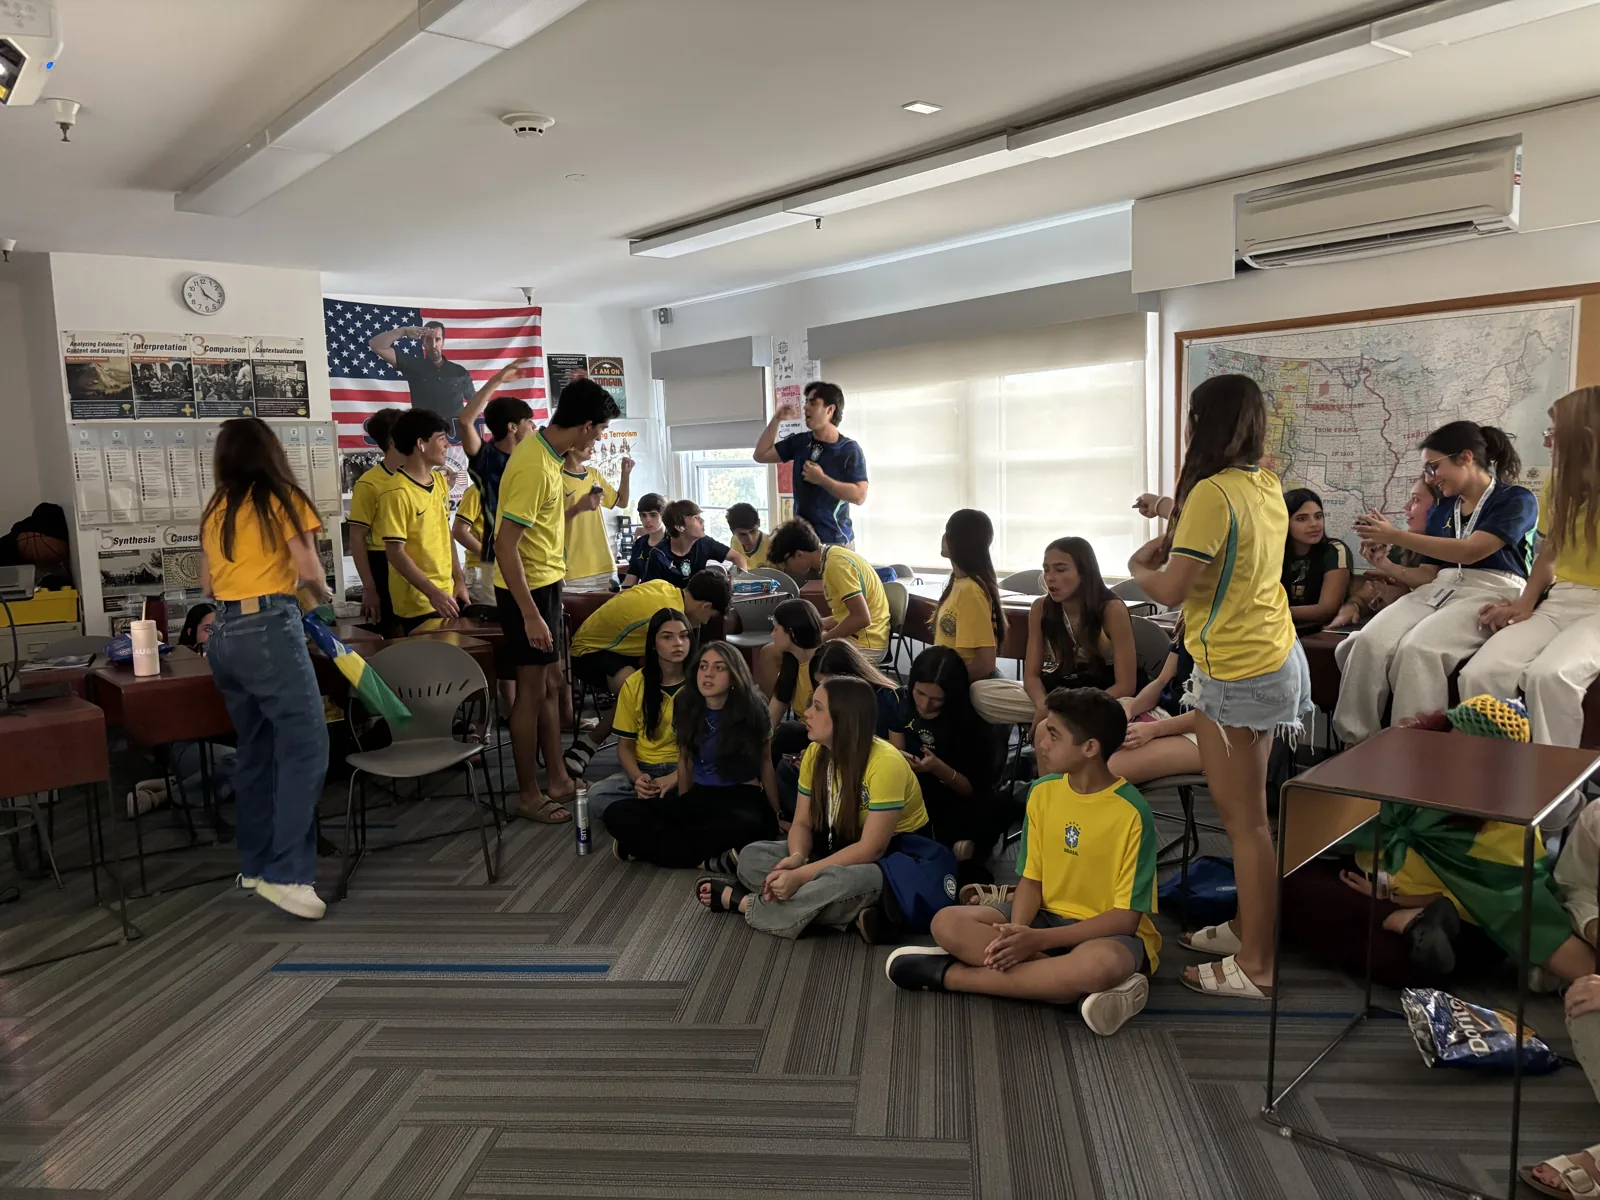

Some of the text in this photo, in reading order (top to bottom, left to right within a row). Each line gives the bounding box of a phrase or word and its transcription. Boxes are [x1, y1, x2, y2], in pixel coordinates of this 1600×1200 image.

[130, 334, 147, 354] 2
[133, 342, 187, 351] Interpretation
[192, 336, 206, 356] 3
[204, 345, 246, 353] Comparison
[252, 339, 265, 357] 4
[609, 430, 638, 438] Terrorism
[101, 529, 115, 549] 5
[113, 535, 156, 546] Synthesis
[163, 526, 178, 546] 6
[170, 533, 199, 543] Causa
